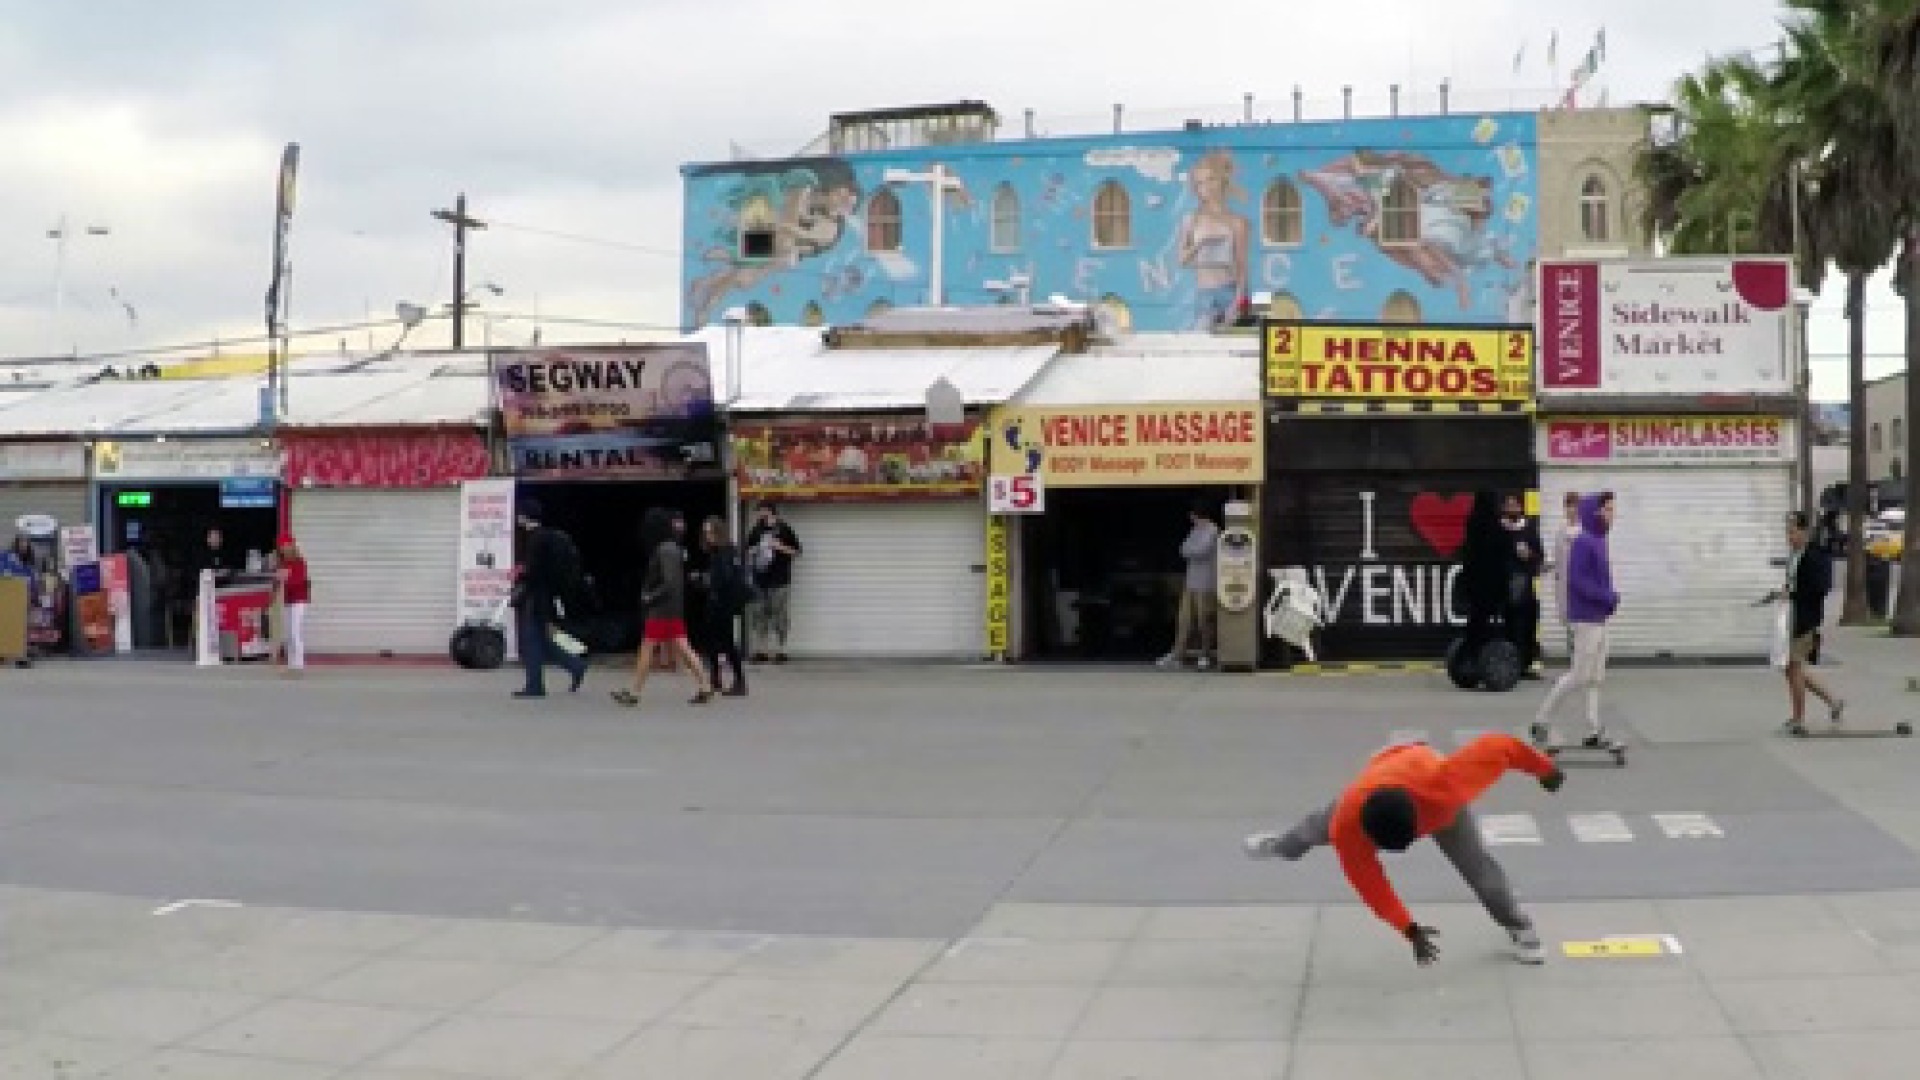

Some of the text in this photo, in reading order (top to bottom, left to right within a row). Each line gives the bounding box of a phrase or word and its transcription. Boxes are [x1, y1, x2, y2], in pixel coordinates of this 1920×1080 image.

[1010, 253, 1363, 296] VENCE
[1557, 269, 1582, 381] VENICE
[1611, 302, 1750, 325] Sidewalk
[1275, 328, 1292, 355] 2
[1324, 337, 1477, 363] HENNA
[1507, 333, 1526, 360] 2
[1613, 332, 1724, 356] Market
[506, 359, 646, 393] SEGWAY
[1302, 363, 1499, 395] TATTOOS
[1041, 410, 1256, 447] VENICE MASSAGE
[1616, 420, 1780, 447] SUNGLASSES
[524, 448, 643, 469] RENTAL
[1049, 452, 1253, 476] BODY Massage FOOT Massage
[1359, 490, 1379, 560] I
[990, 514, 1007, 646] ASSAGE
[1312, 563, 1500, 625] VENIC
